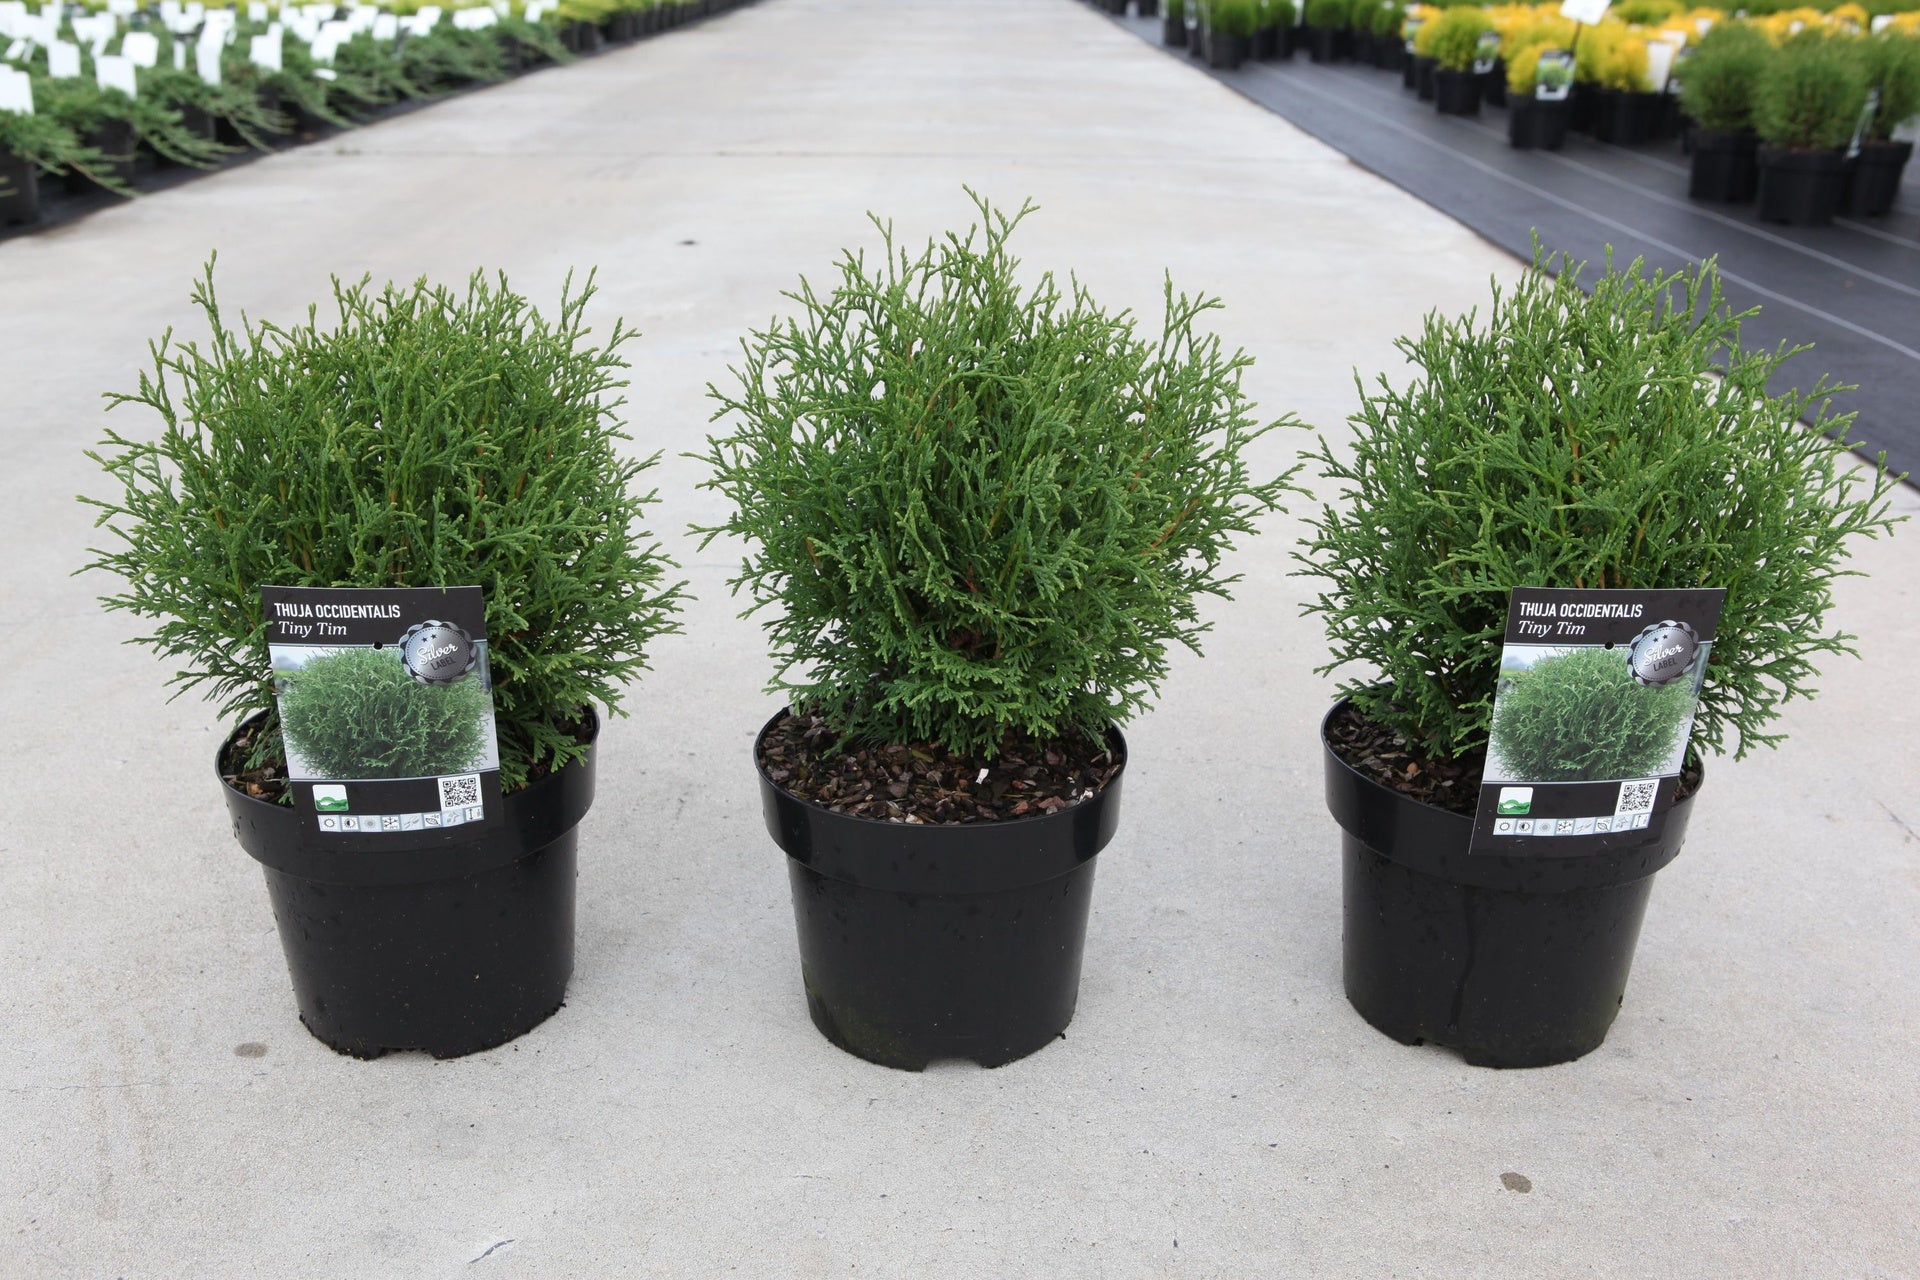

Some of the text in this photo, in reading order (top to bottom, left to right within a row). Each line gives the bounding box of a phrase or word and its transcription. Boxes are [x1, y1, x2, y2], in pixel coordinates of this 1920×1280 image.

[274, 602, 401, 618] THUJA OCCIDENTALIS
[1520, 602, 1643, 618] THUJA OCCIDENTALIS
[279, 621, 347, 638] Tiny Tim
[1518, 620, 1586, 637] Tiny Tim
[416, 643, 458, 665] Silver
[1643, 644, 1684, 666] Silver
[430, 656, 456, 671] LABEL
[1653, 657, 1678, 672] LABEL
